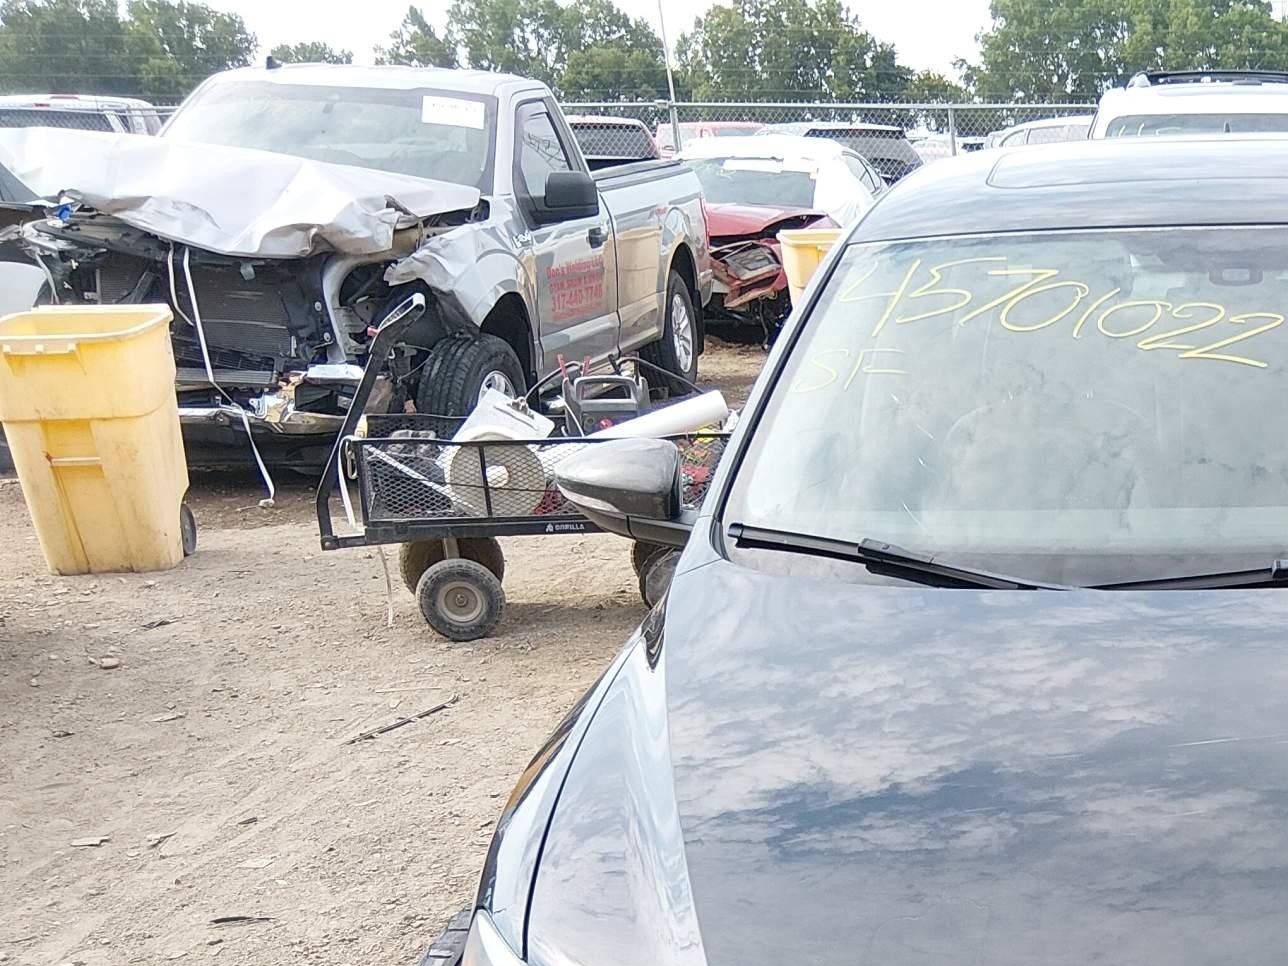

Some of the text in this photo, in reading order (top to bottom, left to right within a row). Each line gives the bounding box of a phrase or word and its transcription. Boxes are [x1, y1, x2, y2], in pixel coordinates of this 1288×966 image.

[838, 256, 1285, 368] 45701022
[792, 348, 909, 393] SF
[554, 523, 585, 531] GORILLA
